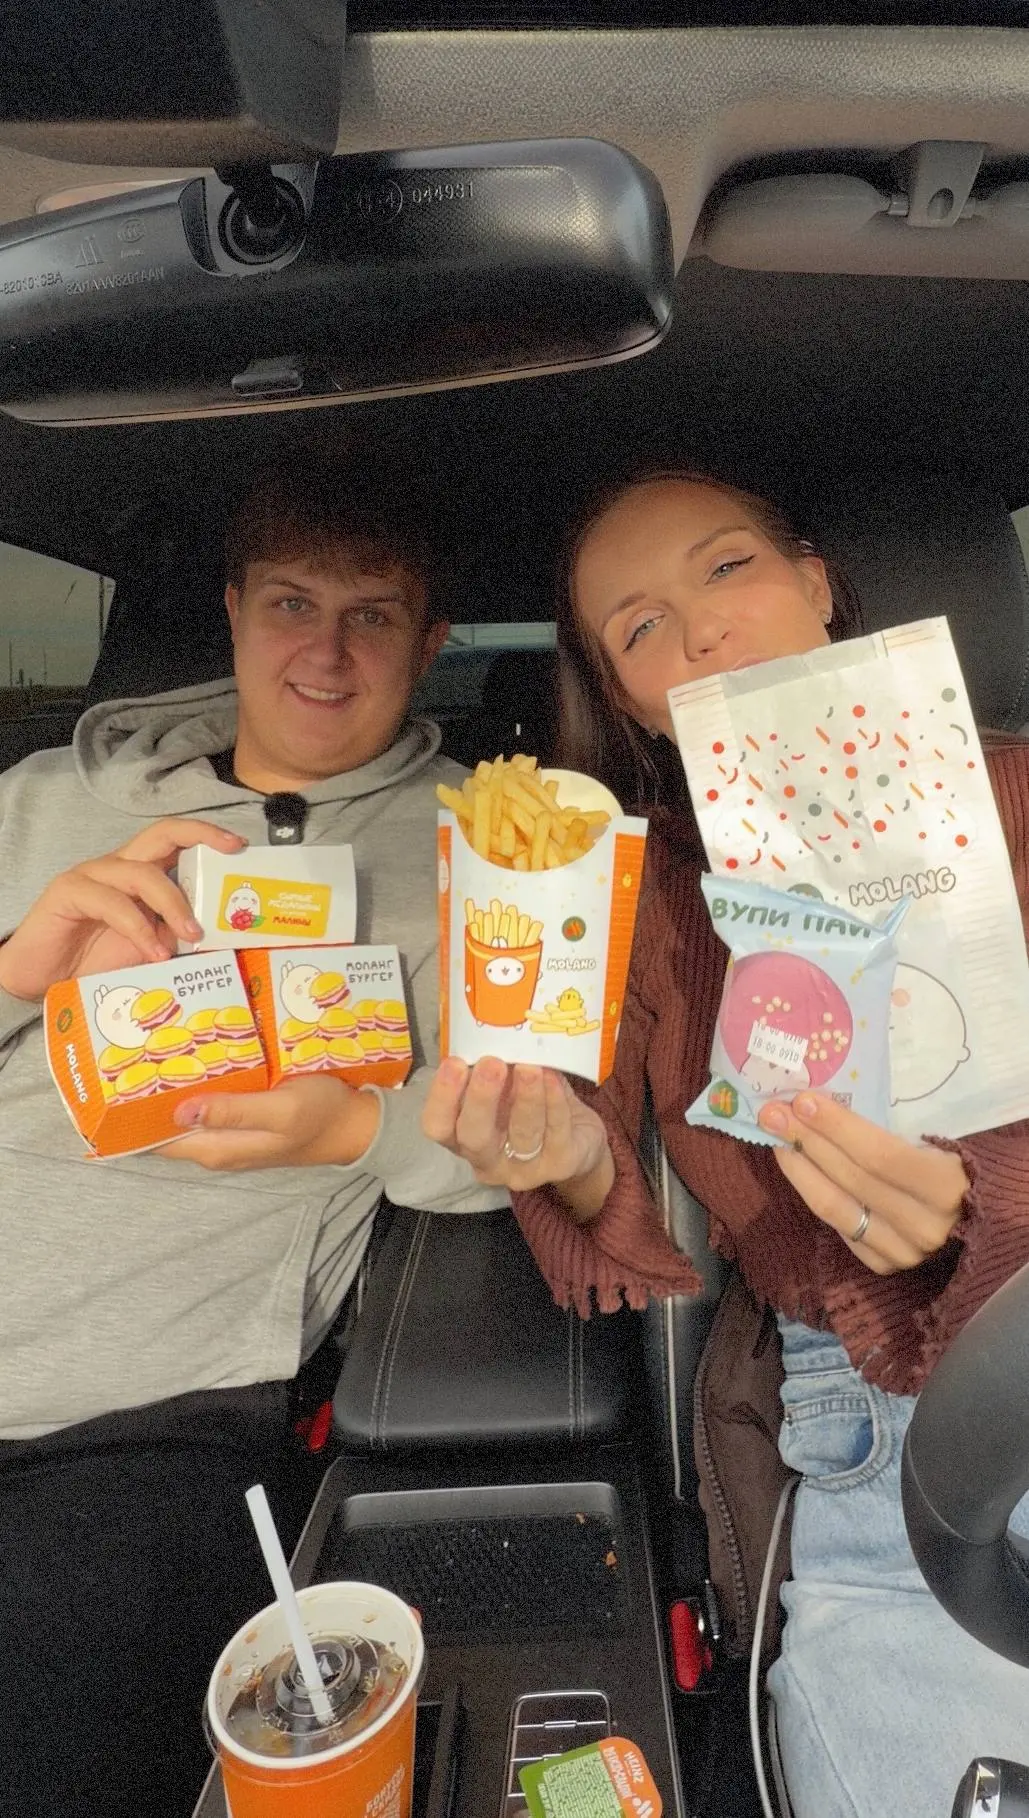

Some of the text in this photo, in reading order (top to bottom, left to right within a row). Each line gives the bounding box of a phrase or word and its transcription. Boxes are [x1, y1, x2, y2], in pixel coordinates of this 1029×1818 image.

[849, 866, 956, 907] MOLANG
[712, 898, 790, 928] ВУПИ
[173, 964, 232, 985] МОЛАНГ
[346, 960, 395, 972] МОЛАНГ
[348, 972, 395, 984] БУРГЕР
[177, 977, 233, 998] БУРГЕР
[65, 1043, 88, 1104] MOLANG
[624, 1751, 645, 1784] HEINZ
